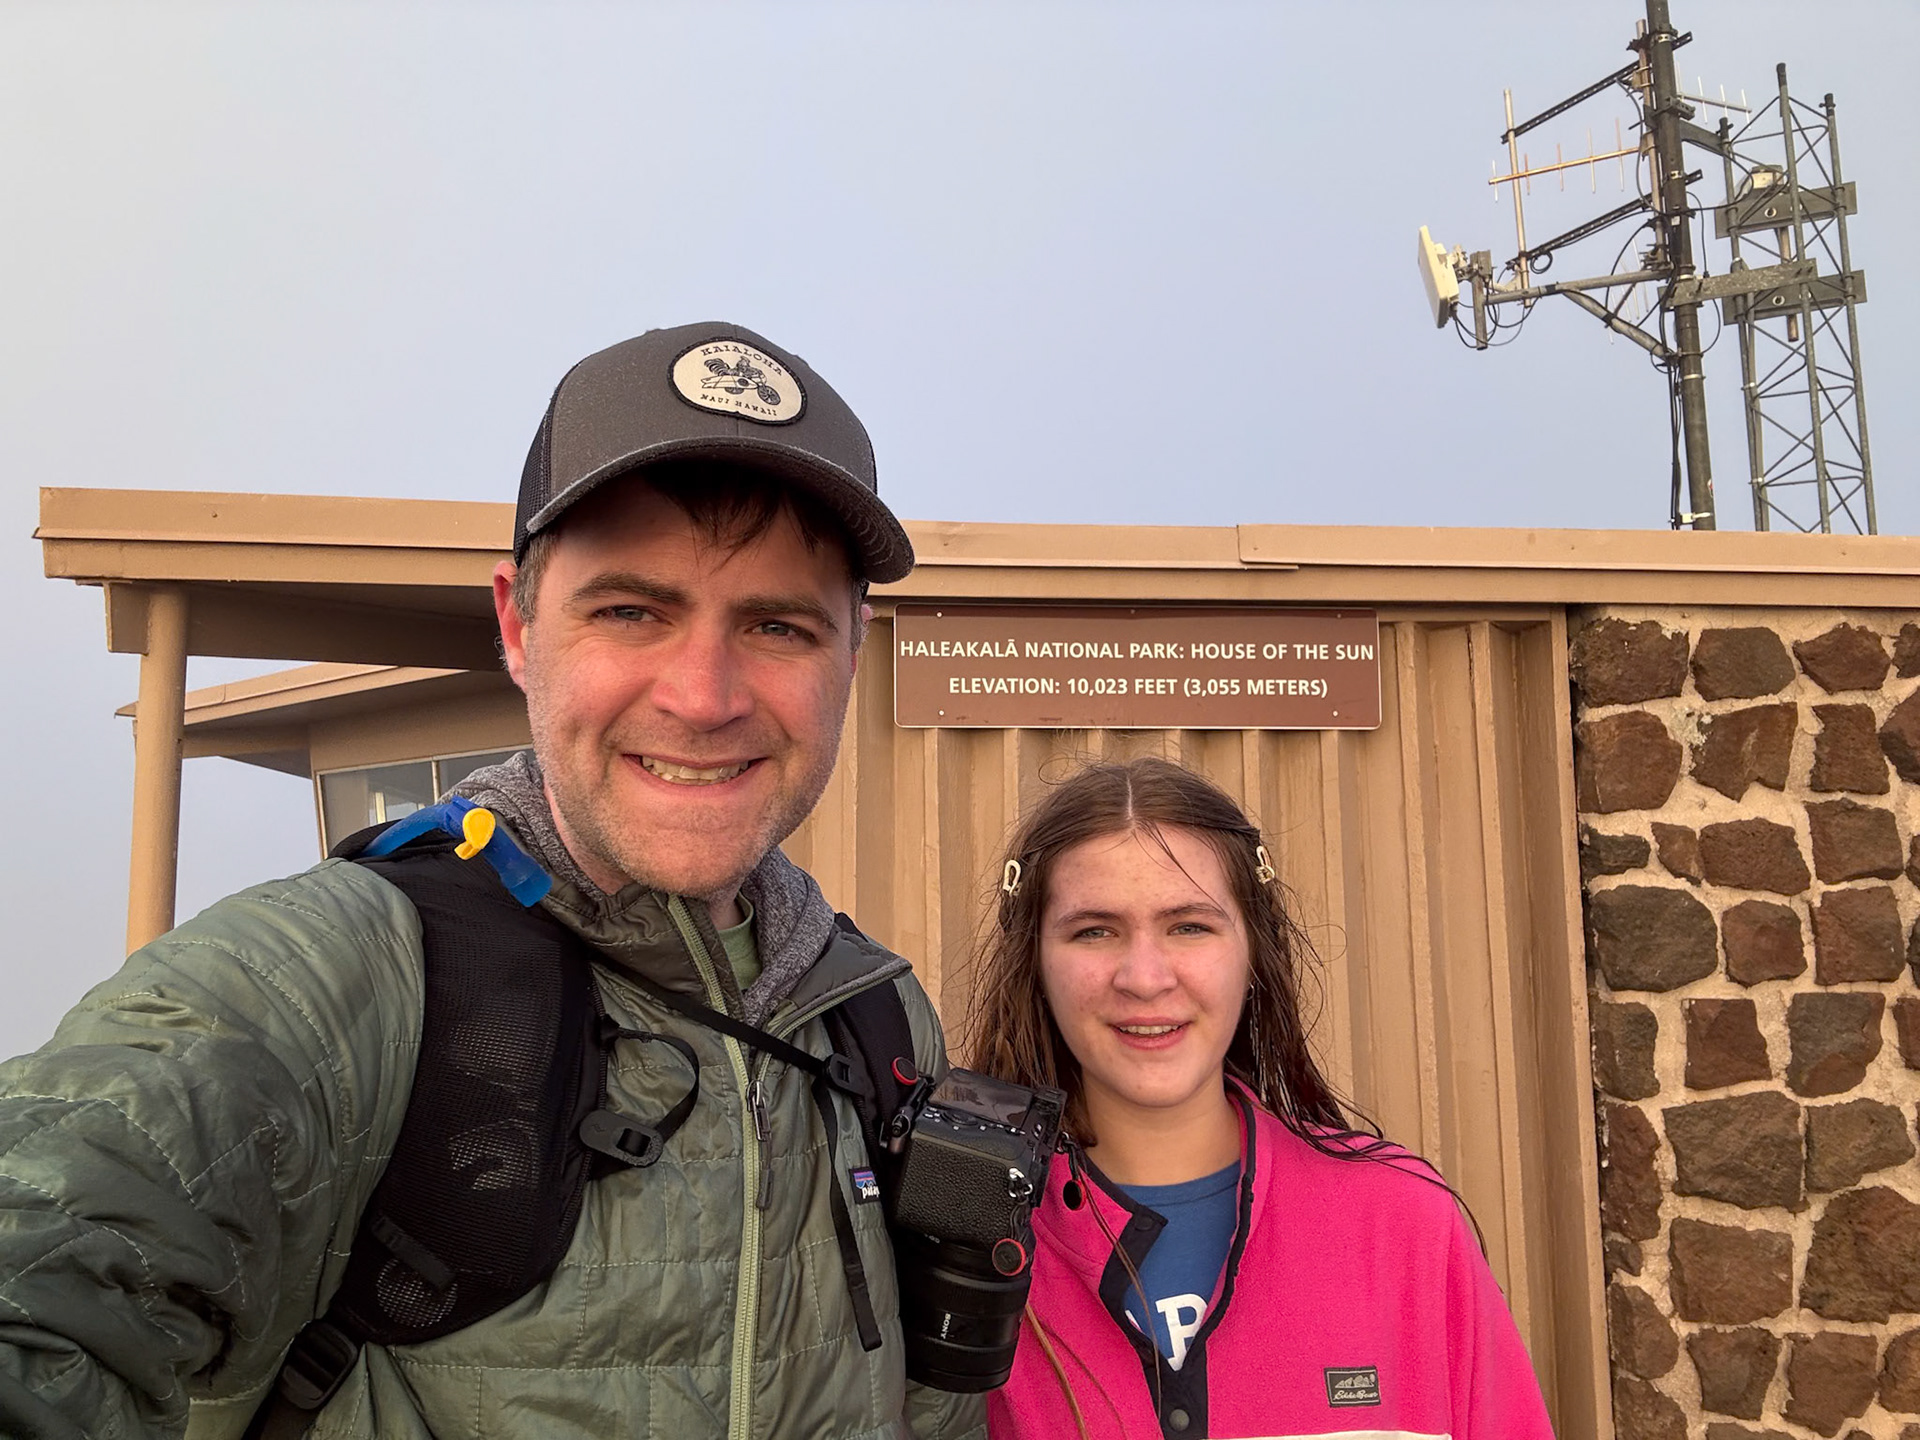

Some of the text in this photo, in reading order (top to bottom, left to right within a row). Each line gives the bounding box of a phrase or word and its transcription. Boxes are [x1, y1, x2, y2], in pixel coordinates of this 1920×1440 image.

[700, 344, 784, 377] KAIALOHA
[700, 393, 778, 417] MAUI HAWAII
[900, 638, 1375, 662] HALEAKALĀ NATIONAL PARK: HOUSE OF THE SUN
[948, 676, 1329, 700] ELEVATION: 10,023 FEET (3,055 METERS)
[940, 1312, 952, 1340] SONY
